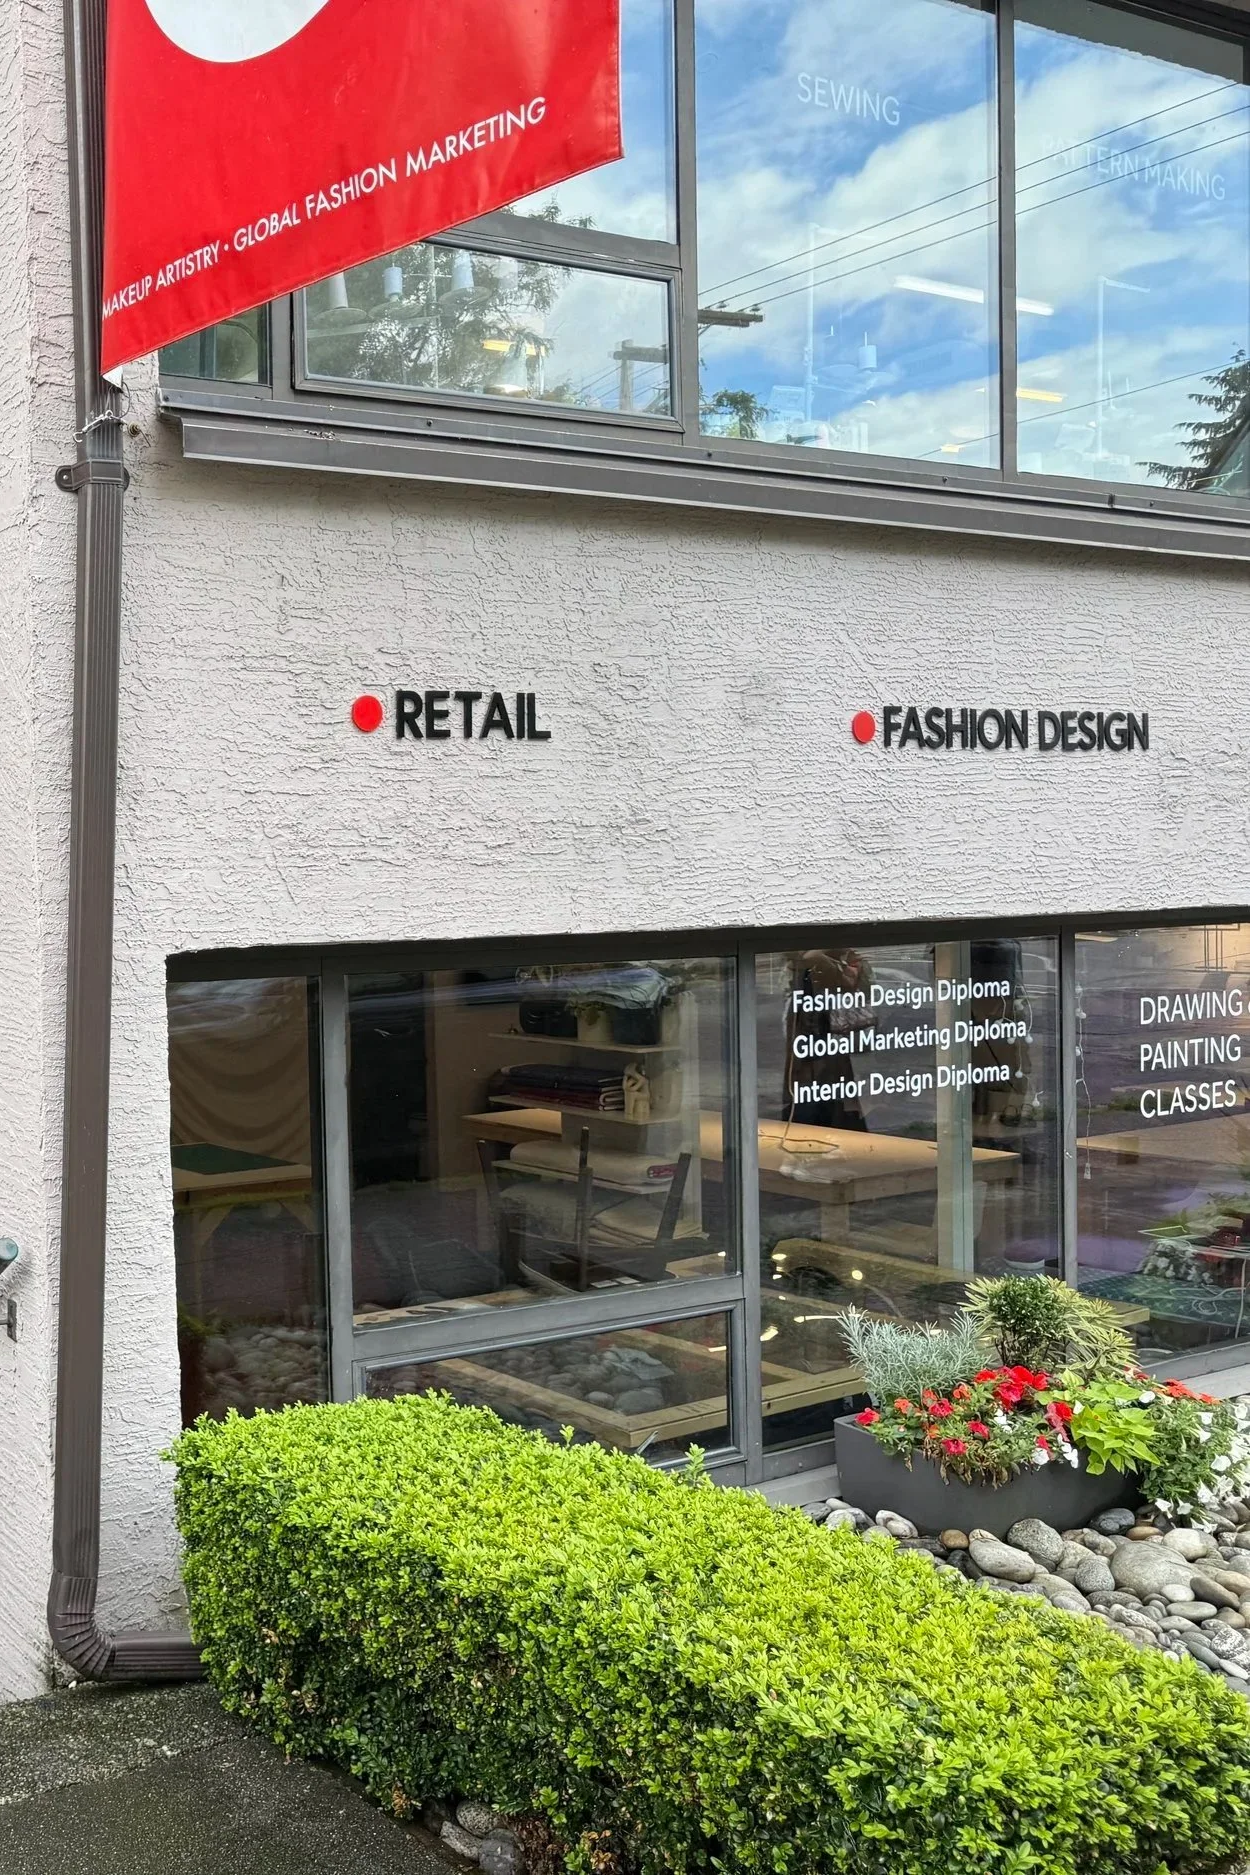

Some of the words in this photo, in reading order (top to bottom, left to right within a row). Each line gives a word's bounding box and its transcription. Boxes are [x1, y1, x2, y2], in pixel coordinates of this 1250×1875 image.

[796, 71, 901, 127] SEWING
[1042, 135, 1139, 182] PATTERN
[1144, 157, 1225, 200] MAKING
[102, 275, 152, 321] MAKEUP
[155, 240, 220, 291] ARTISTRY
[233, 202, 301, 252] GLOBAL
[305, 157, 397, 220] FASHION
[405, 96, 546, 177] MARKETING
[396, 690, 551, 739] RETAIL
[883, 705, 1028, 750] FASHION
[1037, 710, 1149, 750] DESIGN
[792, 988, 865, 1013] Fashion
[870, 982, 933, 1009] Design
[937, 977, 1010, 1005] Diploma
[1140, 989, 1242, 1025] DRAWING
[793, 1031, 854, 1059] Global
[859, 1024, 950, 1053] Marketing
[955, 1018, 1027, 1047] Diploma
[1140, 1034, 1241, 1072] PAINTING
[793, 1076, 866, 1105] Interior
[870, 1069, 932, 1097] Design
[937, 1063, 1010, 1091] Diploma
[1140, 1079, 1236, 1118] CLASSES
